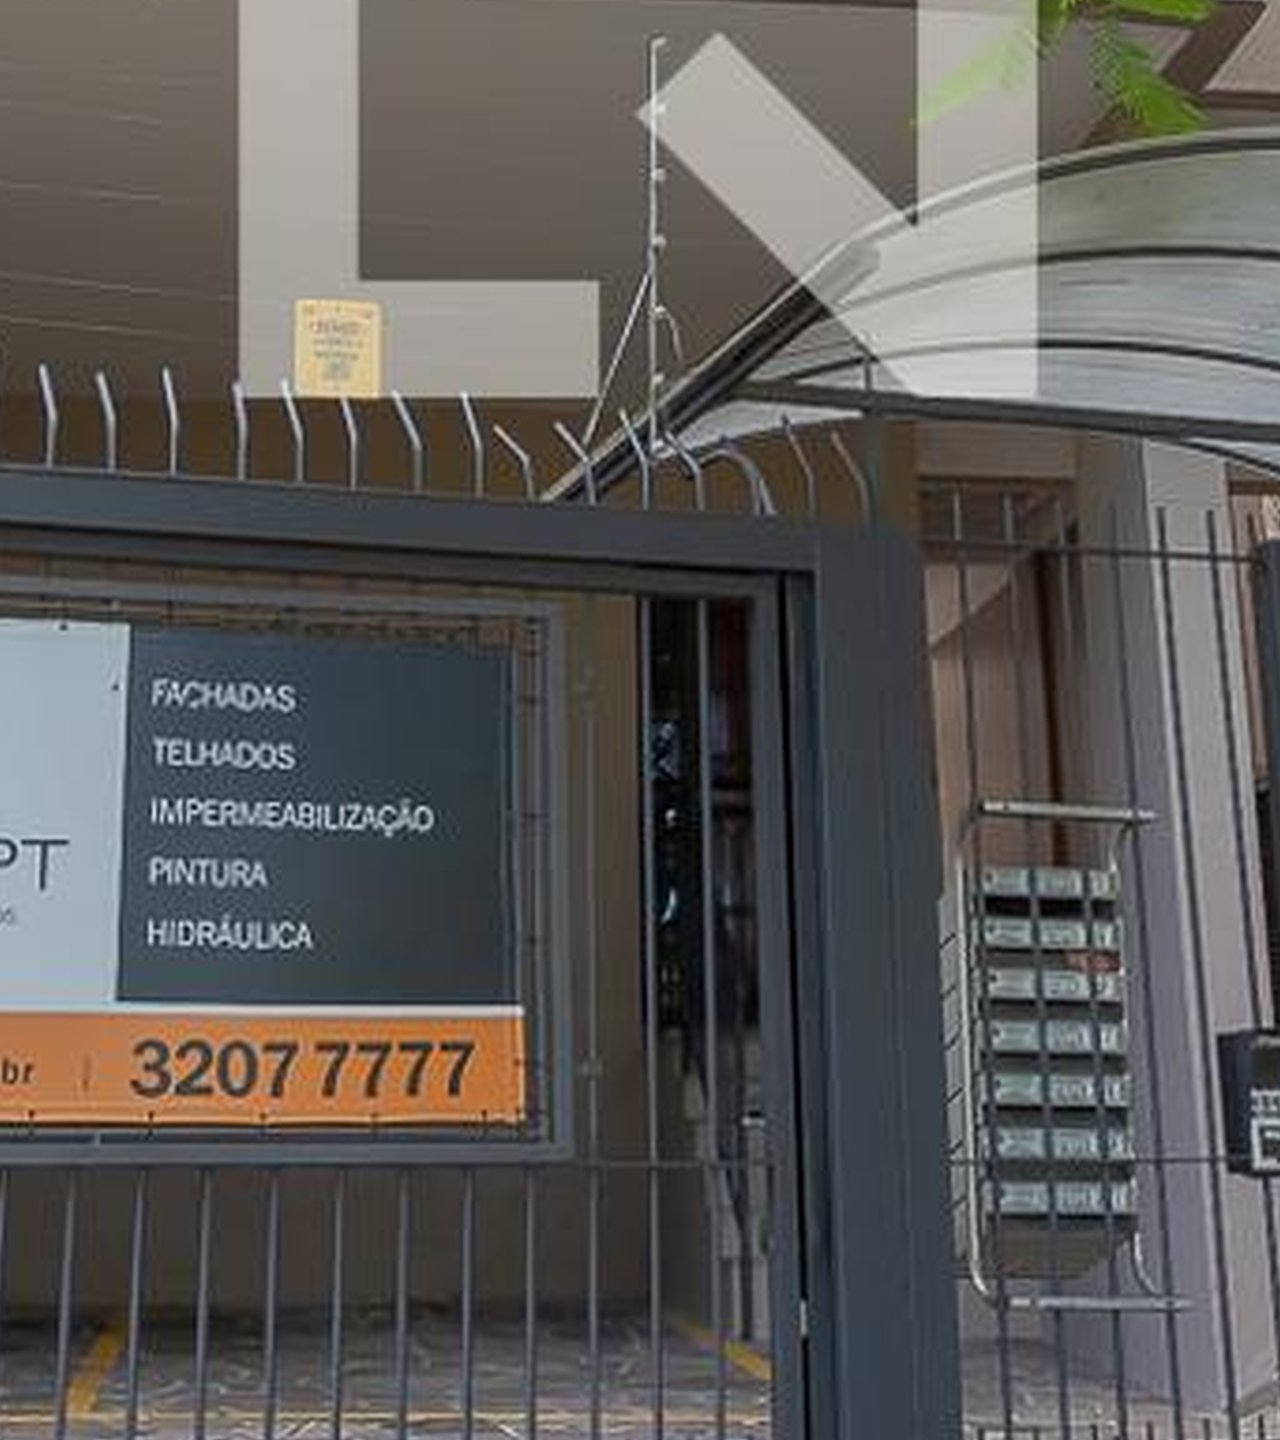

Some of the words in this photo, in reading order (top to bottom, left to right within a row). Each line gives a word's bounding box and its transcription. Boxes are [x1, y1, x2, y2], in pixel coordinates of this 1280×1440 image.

[151, 677, 296, 713] FACHADAS
[153, 735, 296, 770] TELHADOS
[150, 796, 436, 837] IMPERMEABILIZAÇÃO
[149, 855, 268, 888] PINTURA
[147, 914, 313, 950] HIDRÁULICA
[129, 1038, 299, 1099] 3207
[315, 1041, 475, 1098] 7777
